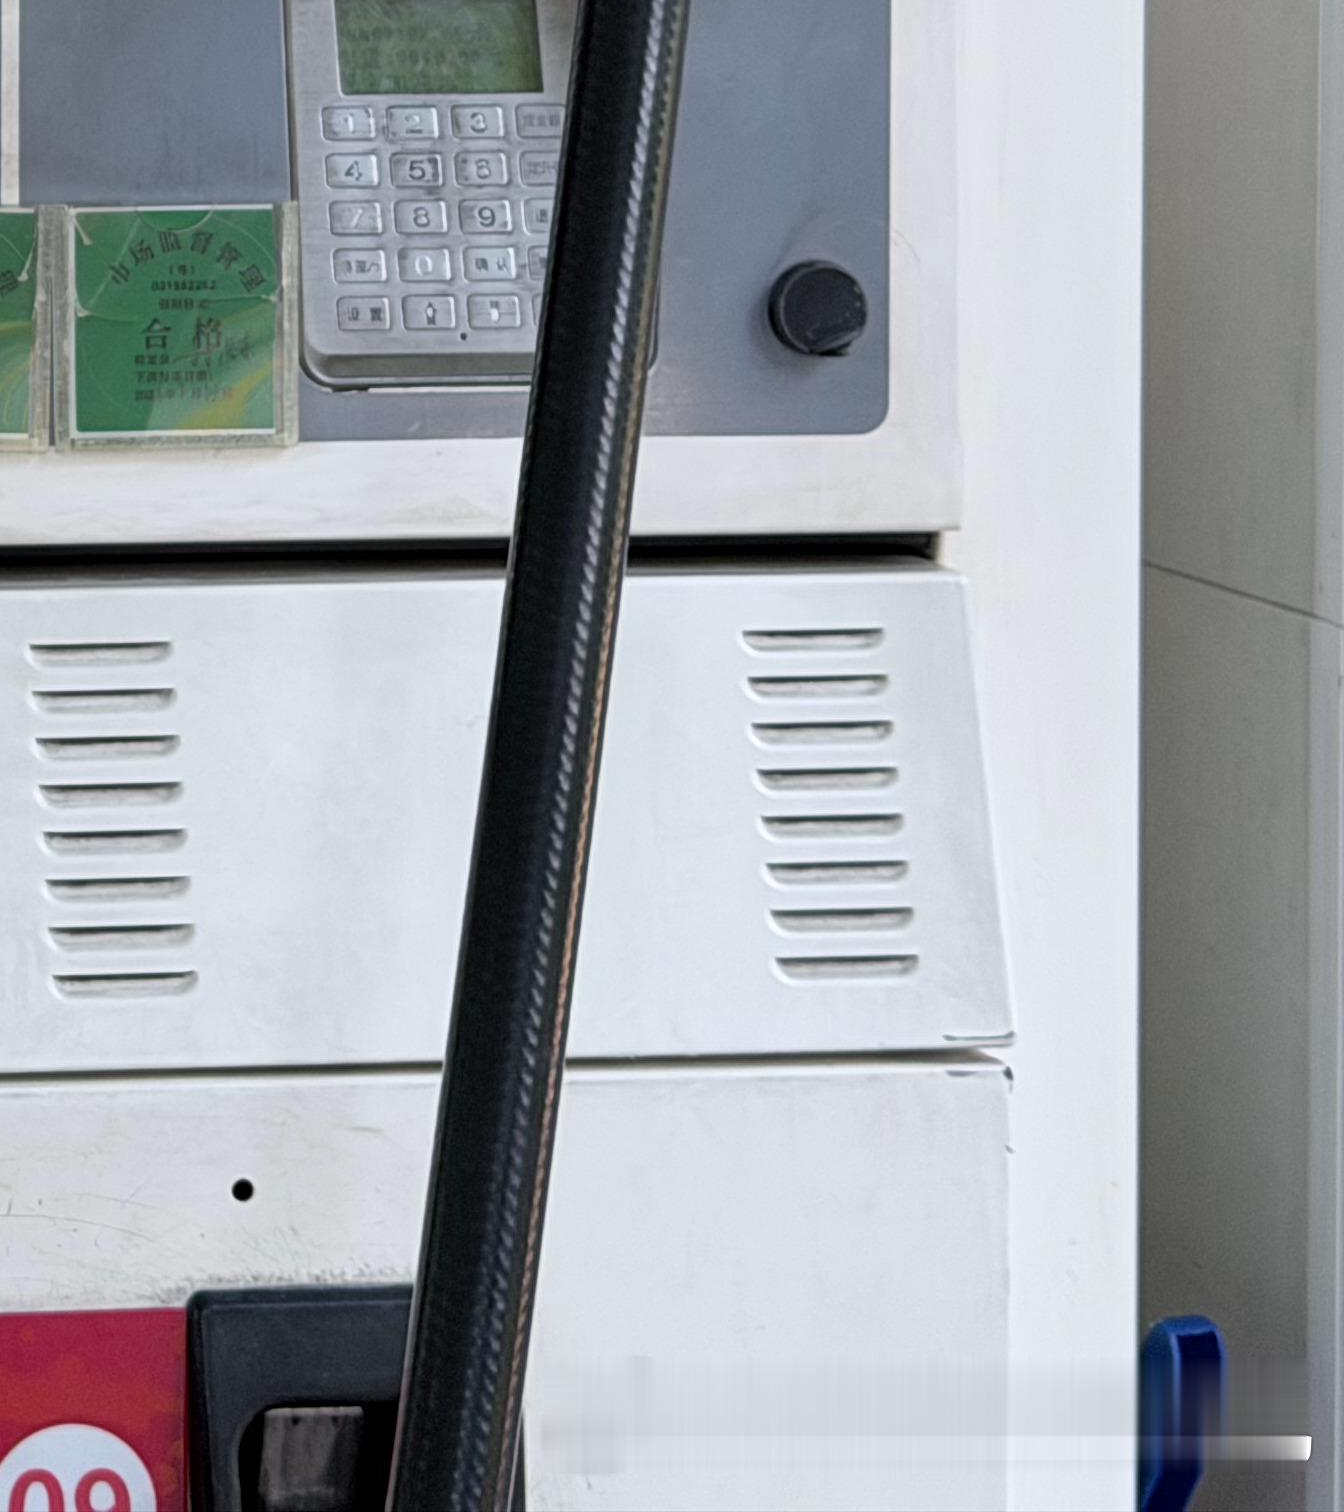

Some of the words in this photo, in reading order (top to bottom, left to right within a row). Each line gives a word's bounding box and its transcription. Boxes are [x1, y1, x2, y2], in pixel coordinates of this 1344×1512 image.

[405, 114, 423, 134] 2
[345, 161, 362, 181] 4
[409, 160, 426, 180] 5
[413, 206, 431, 228] 8
[478, 207, 496, 228] 9
